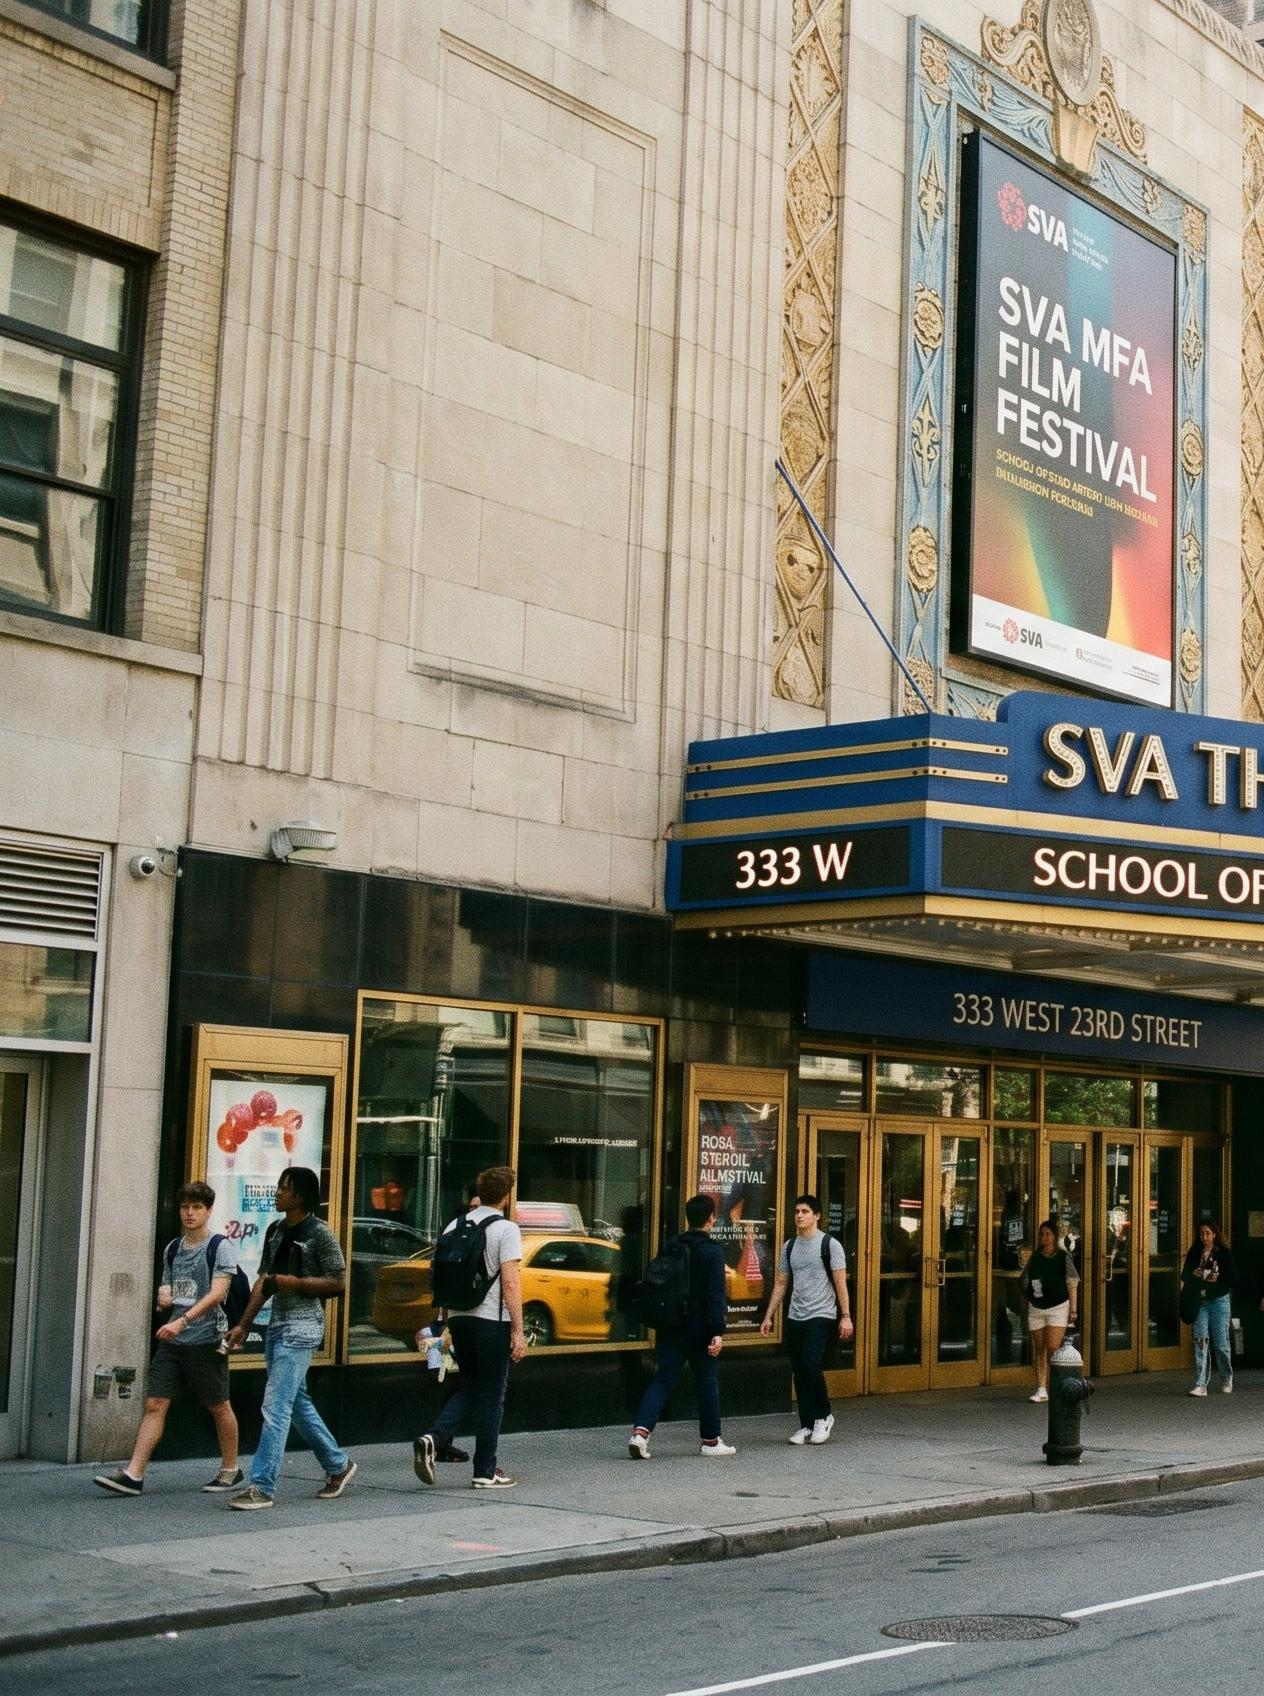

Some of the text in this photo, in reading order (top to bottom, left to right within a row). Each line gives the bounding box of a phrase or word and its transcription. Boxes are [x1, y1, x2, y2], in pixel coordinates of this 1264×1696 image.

[1028, 204, 1069, 252] SVA
[998, 277, 1153, 395] SVA MFA
[998, 330, 1082, 414] FILM
[996, 387, 1157, 503] FESTIVAL
[1020, 628, 1043, 649] SVA
[1042, 722, 1179, 800] SVA
[735, 841, 853, 890] 333 W
[1033, 847, 1208, 901] SCHOOL
[953, 992, 1202, 1049] 333 WEST 23RD STREET
